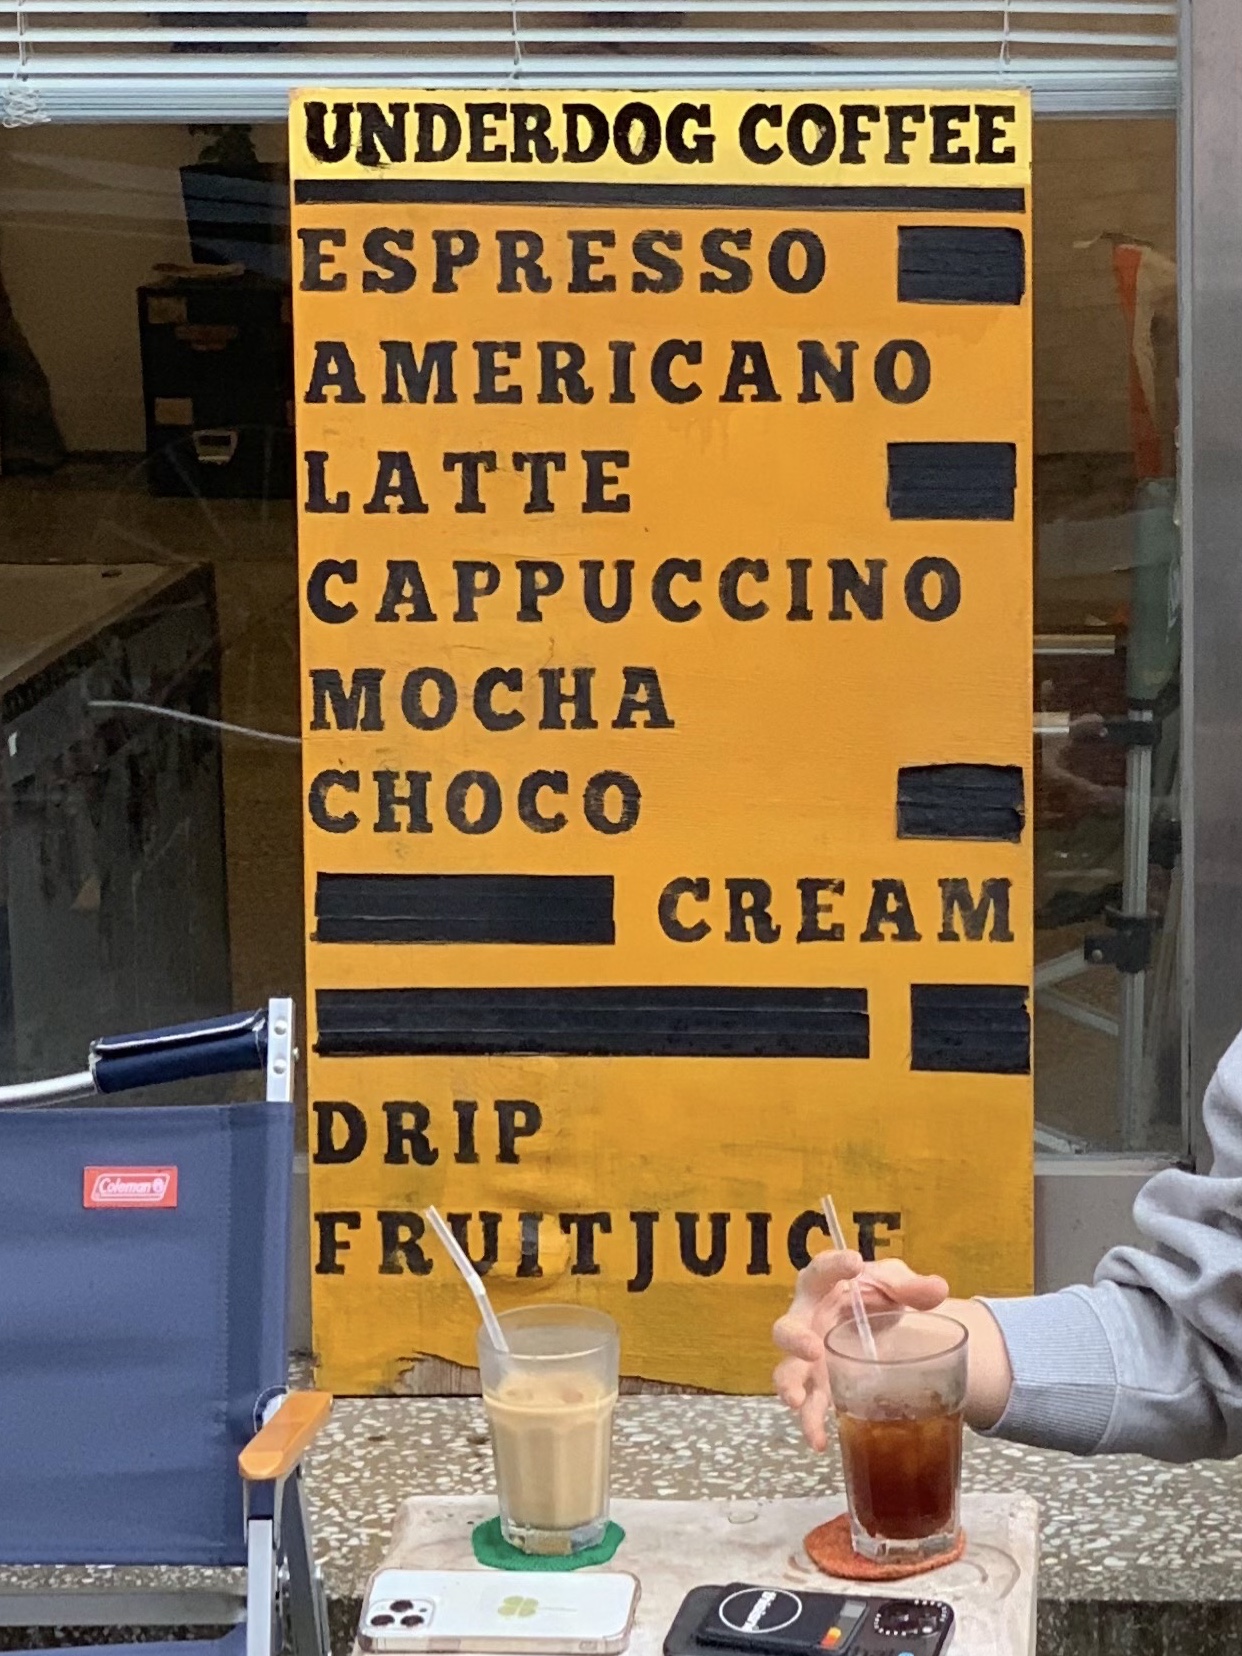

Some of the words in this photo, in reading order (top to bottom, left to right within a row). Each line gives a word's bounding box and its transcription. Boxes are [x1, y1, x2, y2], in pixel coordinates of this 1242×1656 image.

[303, 101, 716, 168] UNDERDOG
[738, 103, 1018, 166] COFFEE
[296, 226, 827, 294] ESPRESSO
[303, 338, 932, 405] AMERICANO
[303, 449, 632, 515] LATTE
[306, 556, 962, 625] CAPPUCCINO
[308, 666, 676, 732] MOCHA
[308, 768, 643, 835] CHOCO
[657, 876, 1015, 944] CREAM
[312, 1099, 543, 1166] DRIP
[98, 1177, 151, 1193] Coleman
